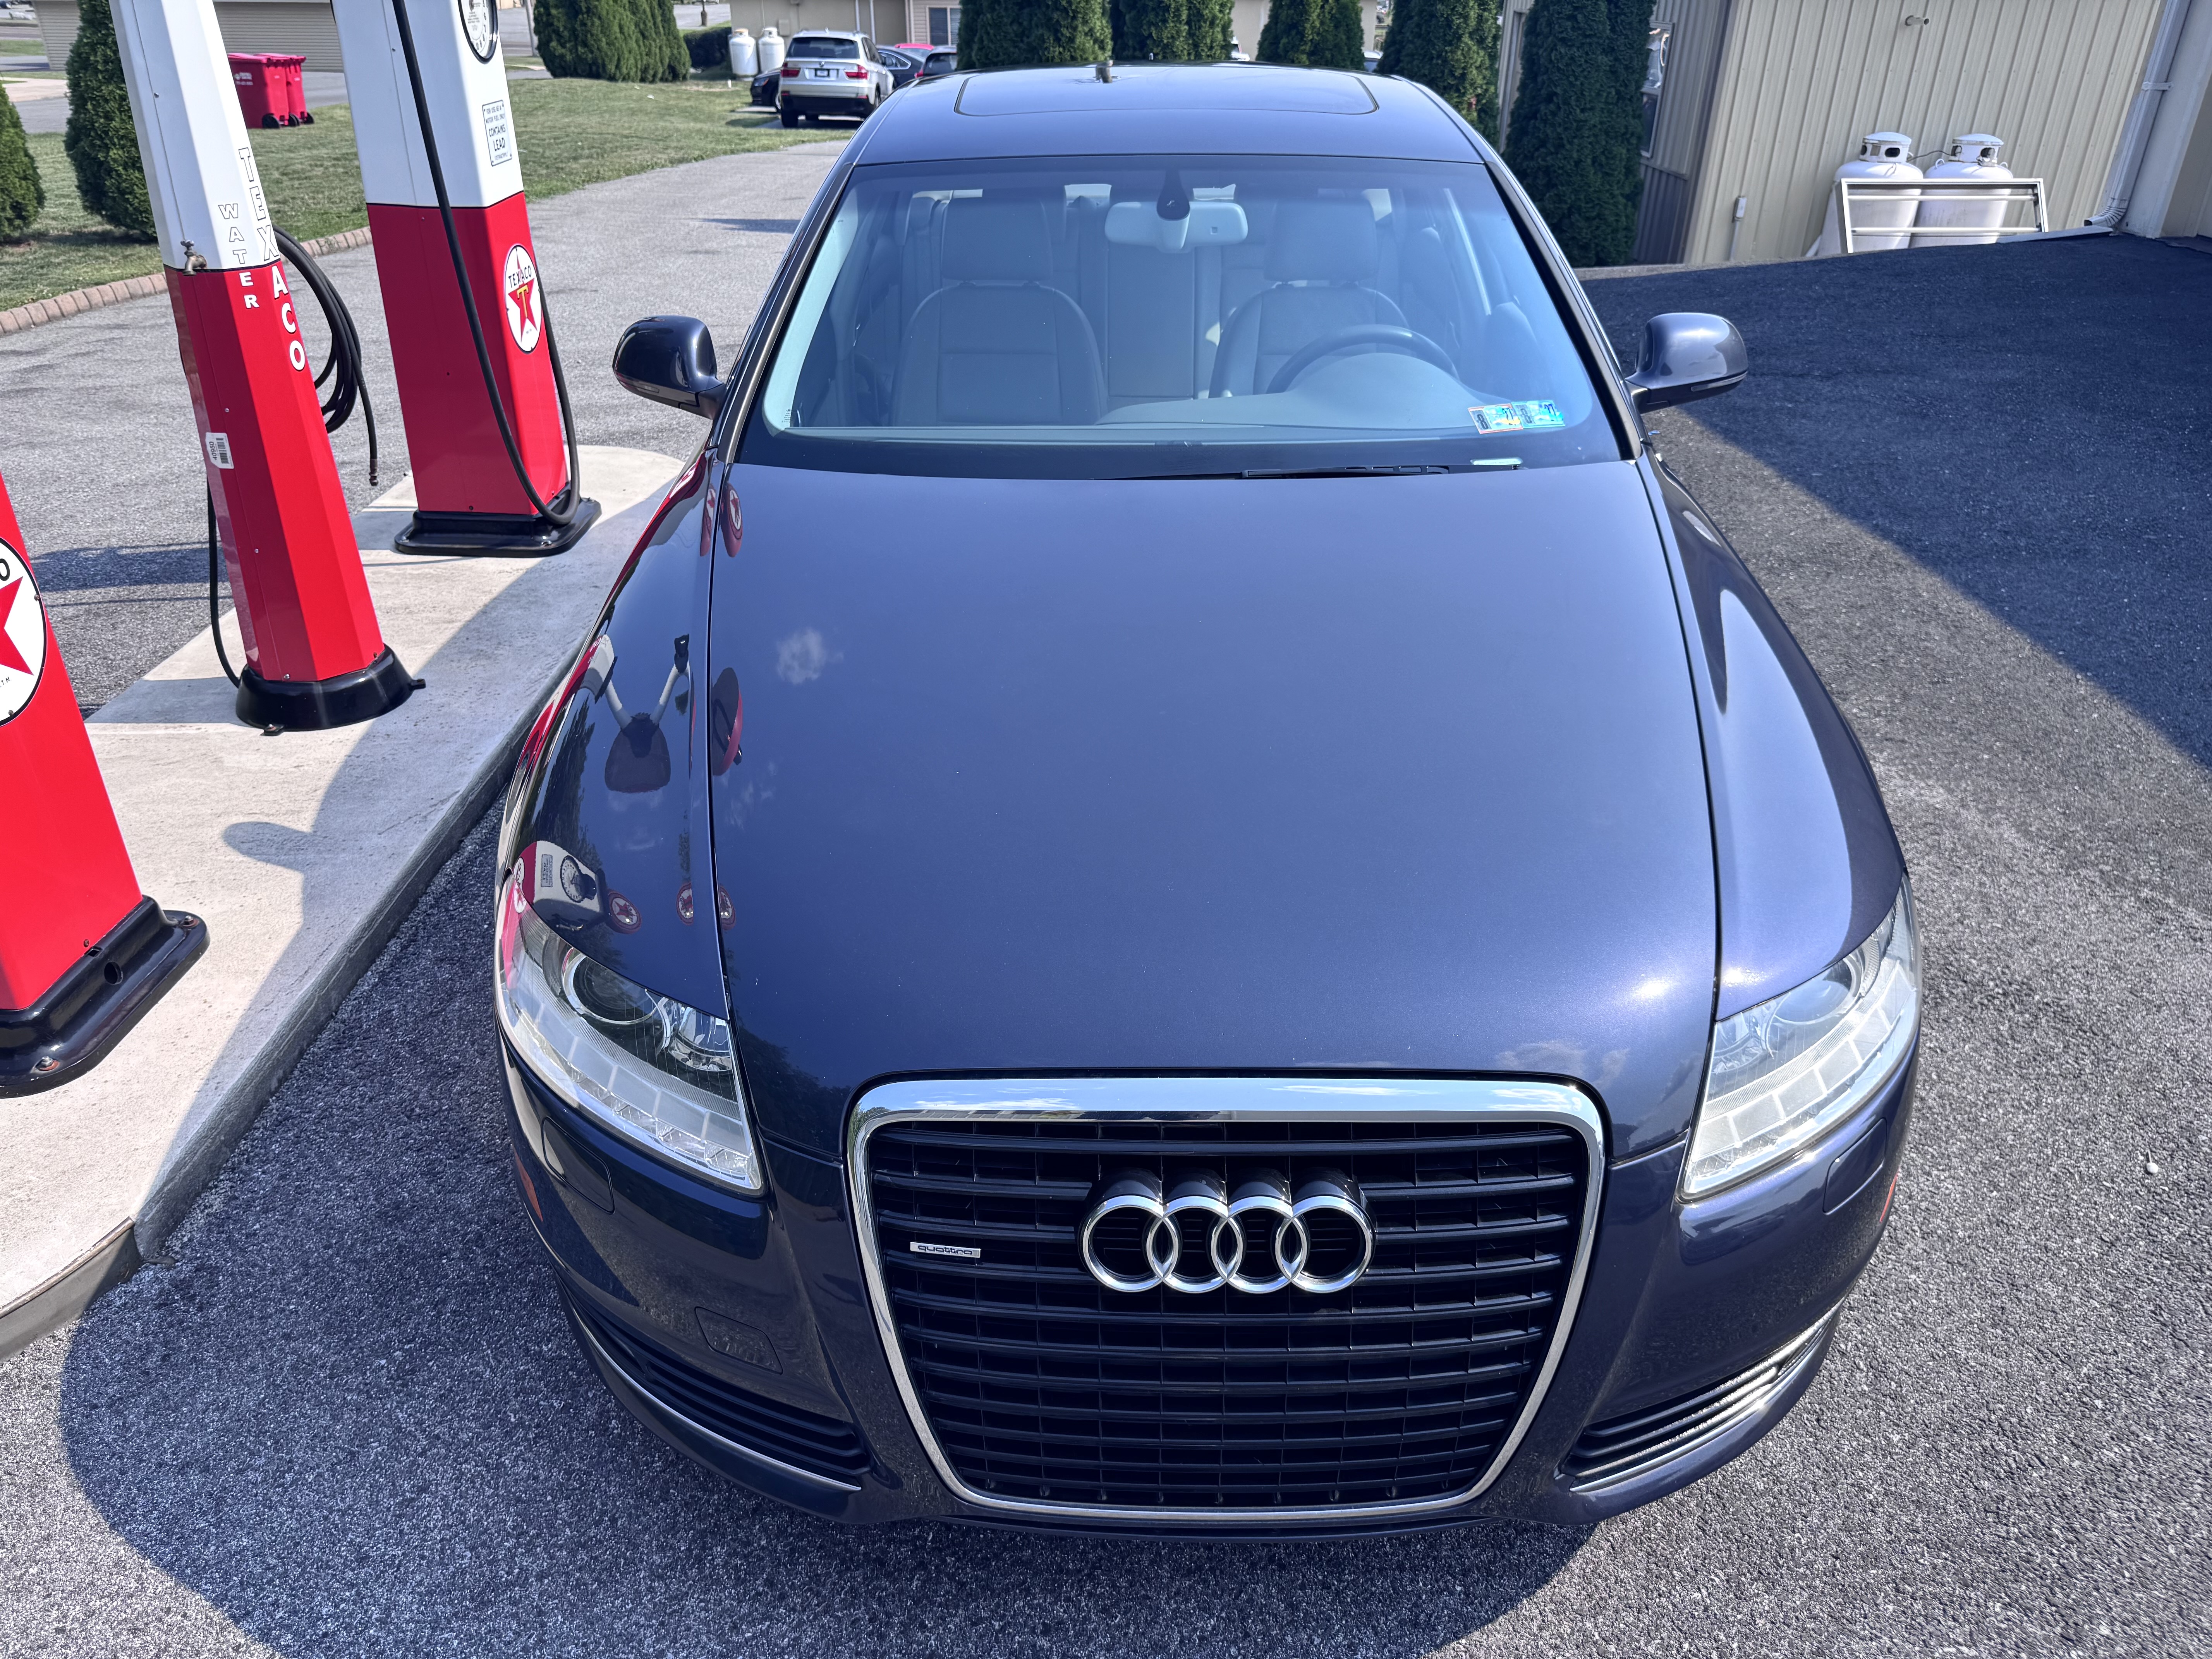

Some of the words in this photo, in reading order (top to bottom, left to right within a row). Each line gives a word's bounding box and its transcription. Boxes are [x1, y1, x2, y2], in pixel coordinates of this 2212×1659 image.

[489, 124, 506, 137] CONTAINS
[493, 137, 505, 151] LEAD
[218, 204, 259, 309] WATER
[239, 147, 305, 371] TEXACO
[508, 265, 532, 288] TEXACO
[918, 1245, 972, 1255] quattro
